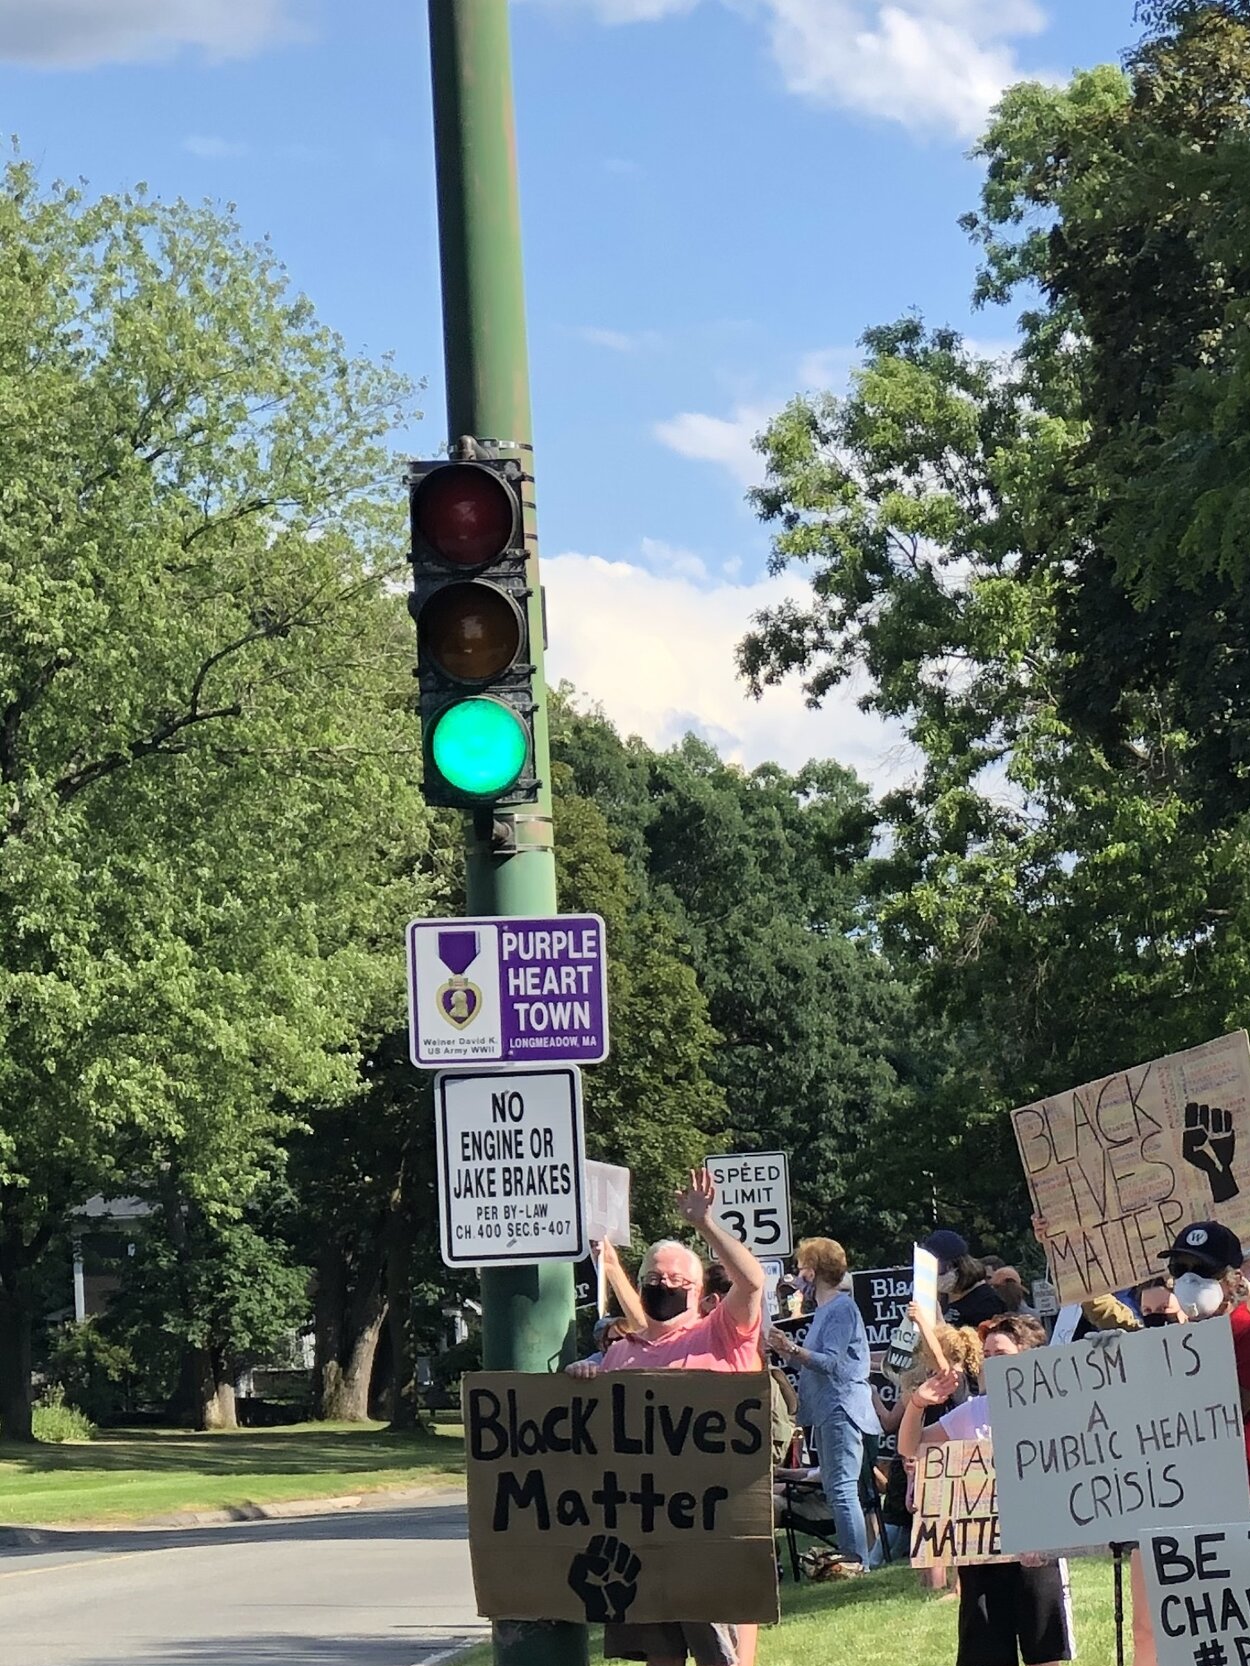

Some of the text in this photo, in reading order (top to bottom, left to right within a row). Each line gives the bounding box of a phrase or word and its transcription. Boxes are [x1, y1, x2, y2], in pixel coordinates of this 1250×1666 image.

[502, 929, 598, 961] PURPLE
[508, 965, 593, 996] HEART
[513, 1001, 591, 1031] TOWN
[428, 1047, 440, 1055] US
[444, 1047, 468, 1056] Army
[459, 1037, 486, 1045] David
[509, 1036, 597, 1049] LONGMEADOW, MA
[491, 1091, 524, 1123] NO
[1014, 1064, 1162, 1174] BLACK
[461, 1128, 554, 1162] ENGINE OR
[454, 1163, 571, 1199] JAKE BRAKES
[714, 1166, 780, 1183] SPEED
[1030, 1130, 1175, 1238] LIVES
[477, 1204, 548, 1220] PER BY-LAW
[722, 1187, 773, 1205] LIMIT
[720, 1208, 781, 1245] 35
[1051, 1199, 1184, 1304] MATTER
[873, 1301, 908, 1321] Liv
[1006, 1333, 1201, 1408] RACISM IS
[1087, 1400, 1109, 1432] A
[1016, 1403, 1241, 1480] PUBLIC HEALTH
[925, 1444, 995, 1479] BLA
[493, 1470, 729, 1532] Matter
[921, 1478, 998, 1518] LIVE
[911, 1516, 1001, 1558] MATTE
[1152, 1532, 1231, 1585] BE
